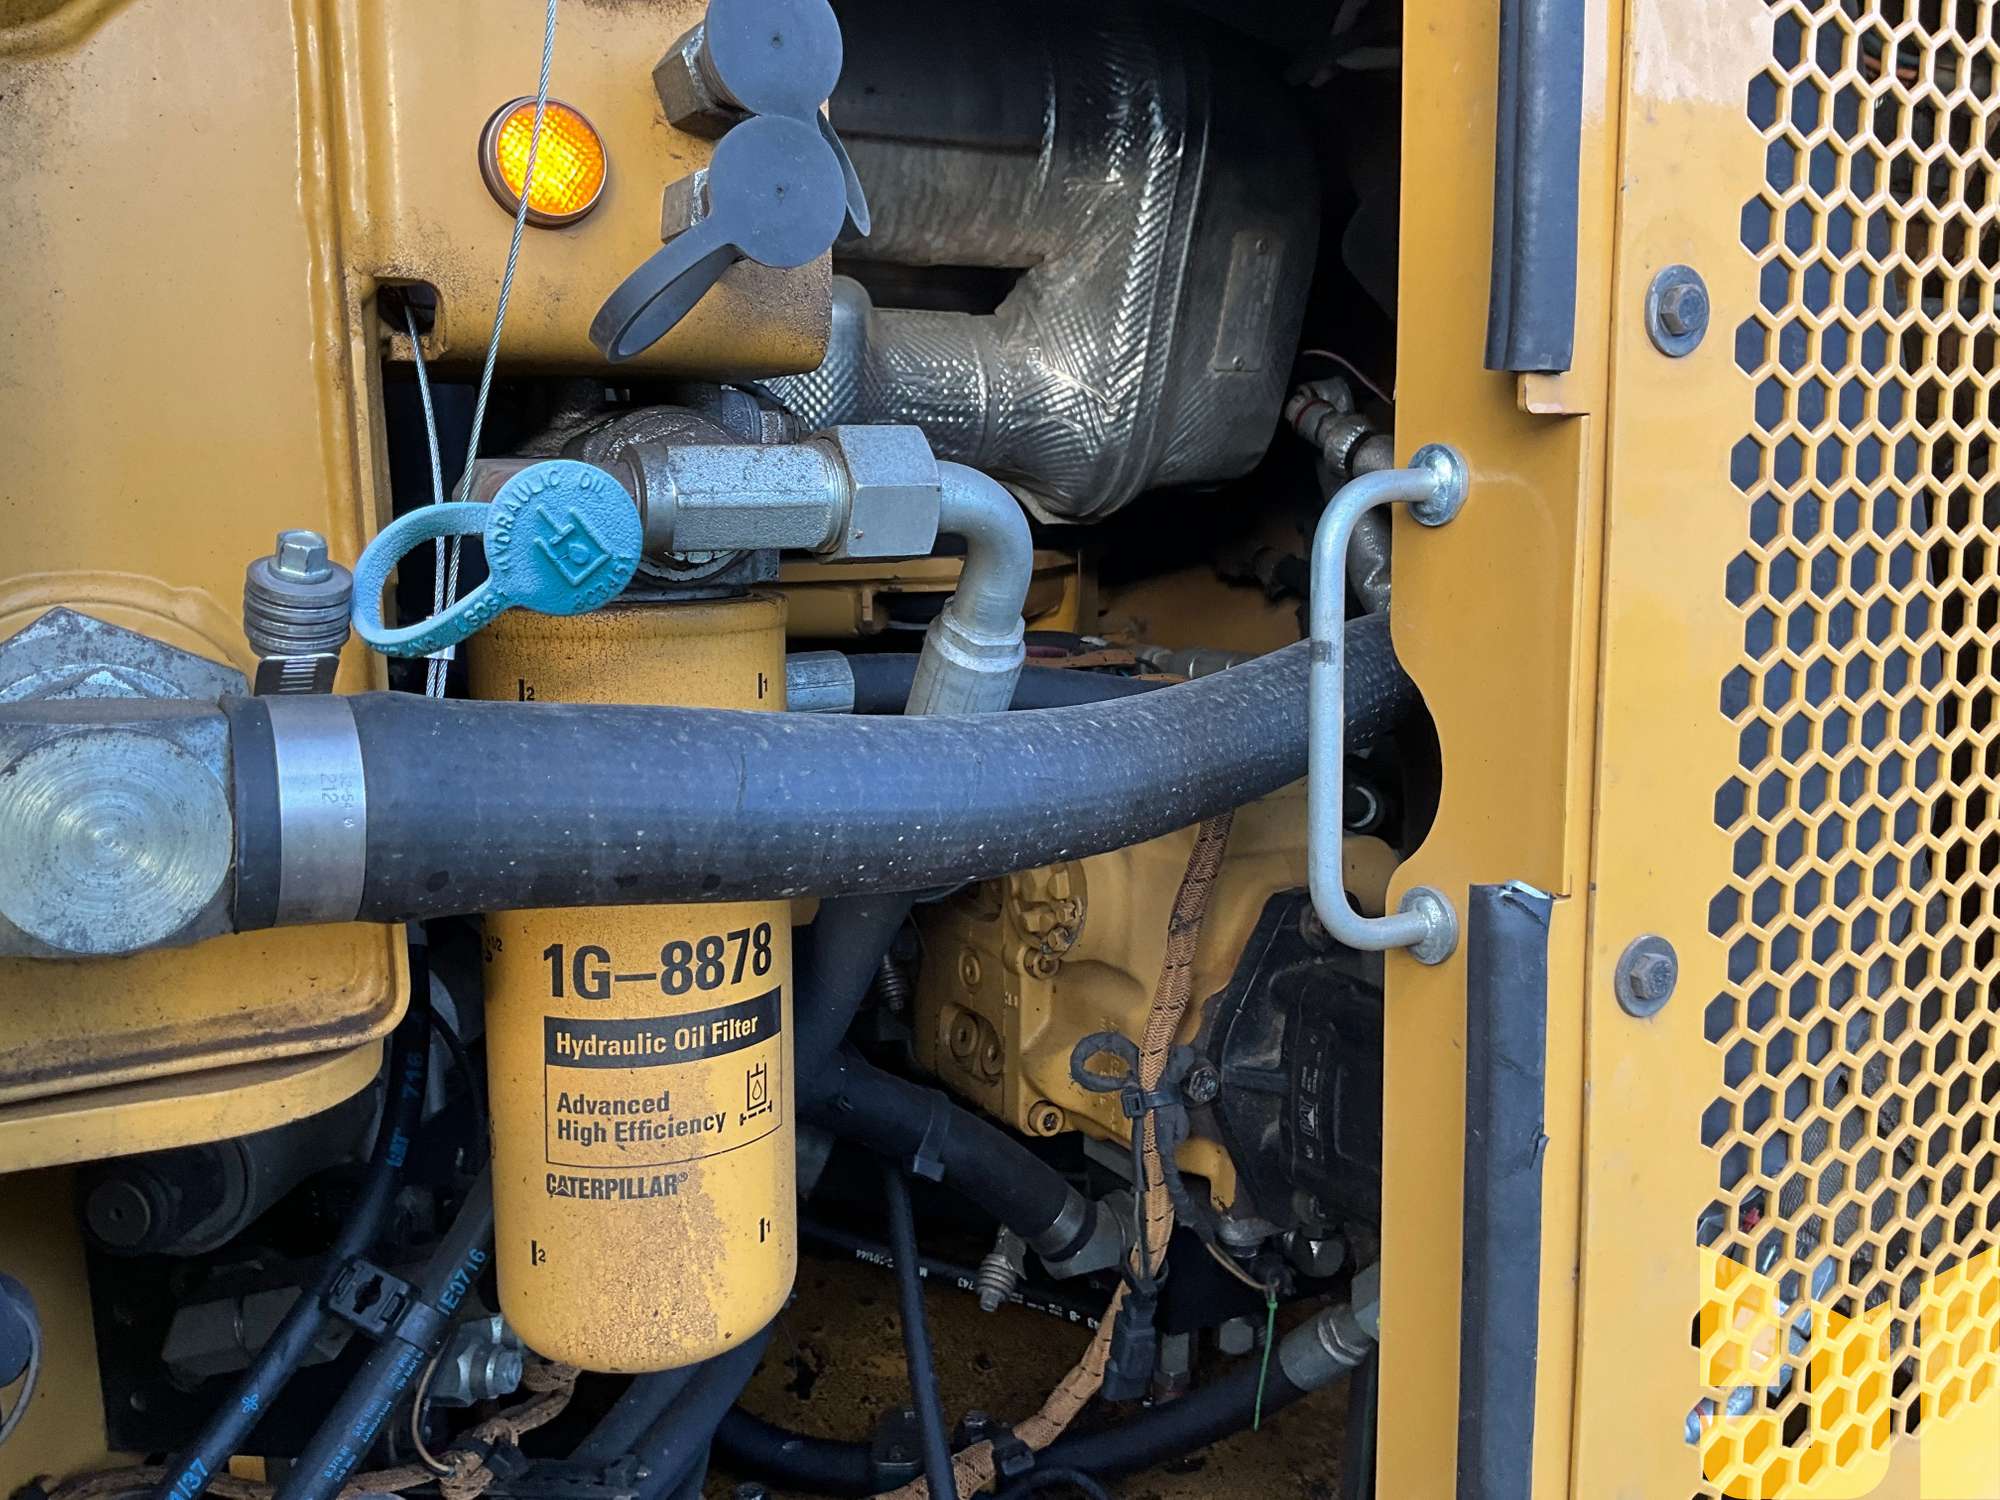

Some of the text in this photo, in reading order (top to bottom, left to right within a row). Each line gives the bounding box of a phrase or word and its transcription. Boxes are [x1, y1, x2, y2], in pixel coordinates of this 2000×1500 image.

[490, 470, 607, 572] HYDRAULIC OIL
[320, 772, 339, 803] 212
[543, 921, 773, 1000] 1G-8878
[556, 1015, 759, 1060] Hydraulic Oil Filter
[556, 1090, 671, 1117] Advanced
[556, 1111, 727, 1147] High Efficiency
